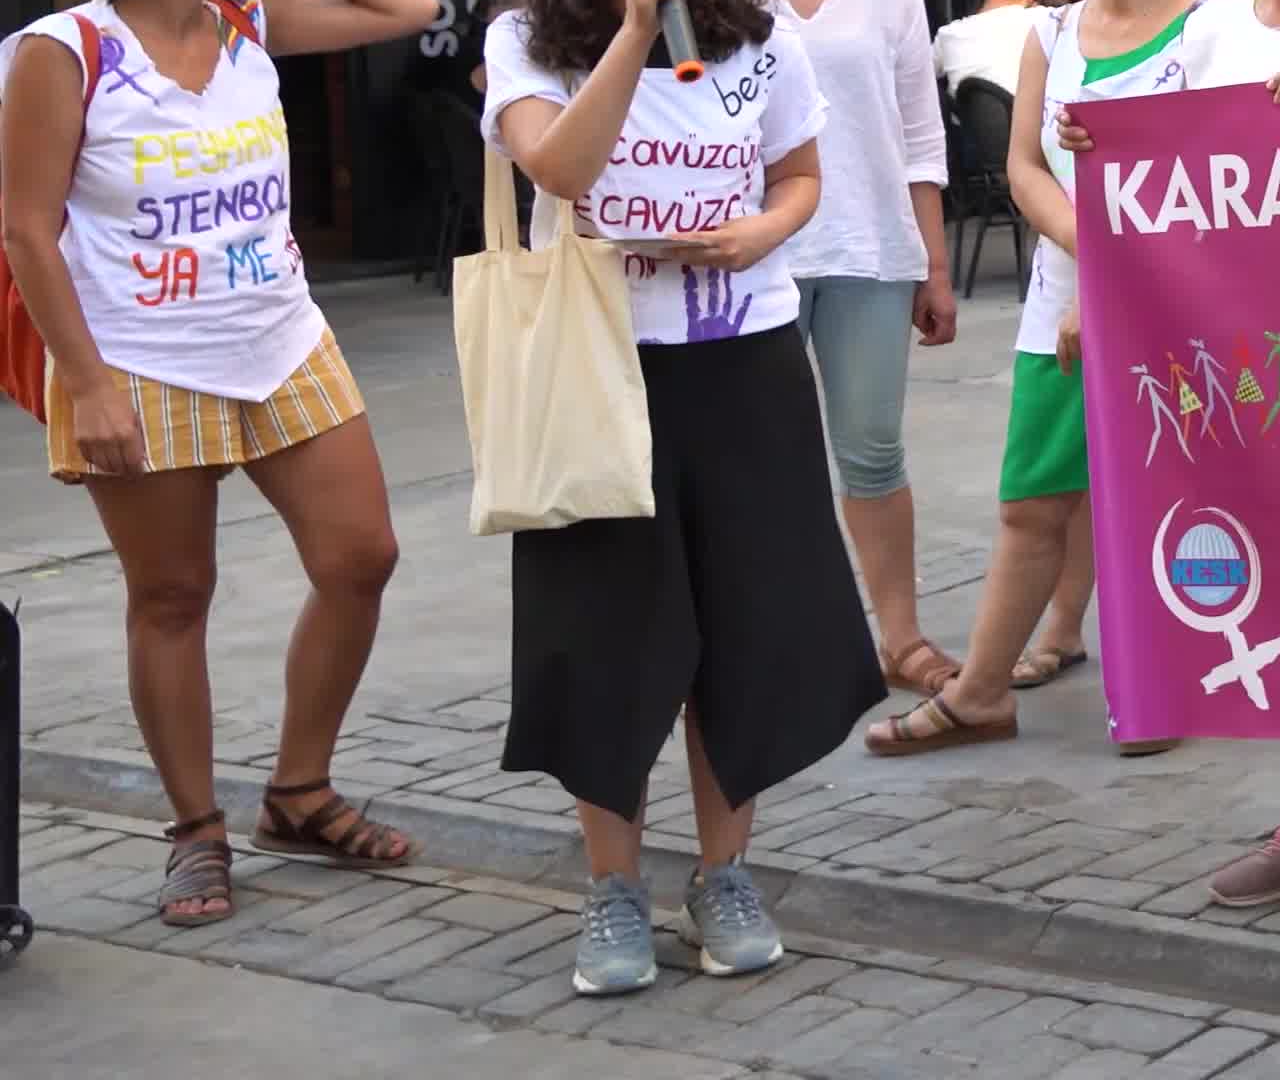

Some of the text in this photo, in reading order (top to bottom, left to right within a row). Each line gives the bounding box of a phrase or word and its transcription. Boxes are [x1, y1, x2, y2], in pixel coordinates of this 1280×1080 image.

[130, 172, 288, 241] STENBOL
[132, 247, 200, 307] YA
[225, 236, 279, 289] ME
[1171, 559, 1249, 585] KESK
